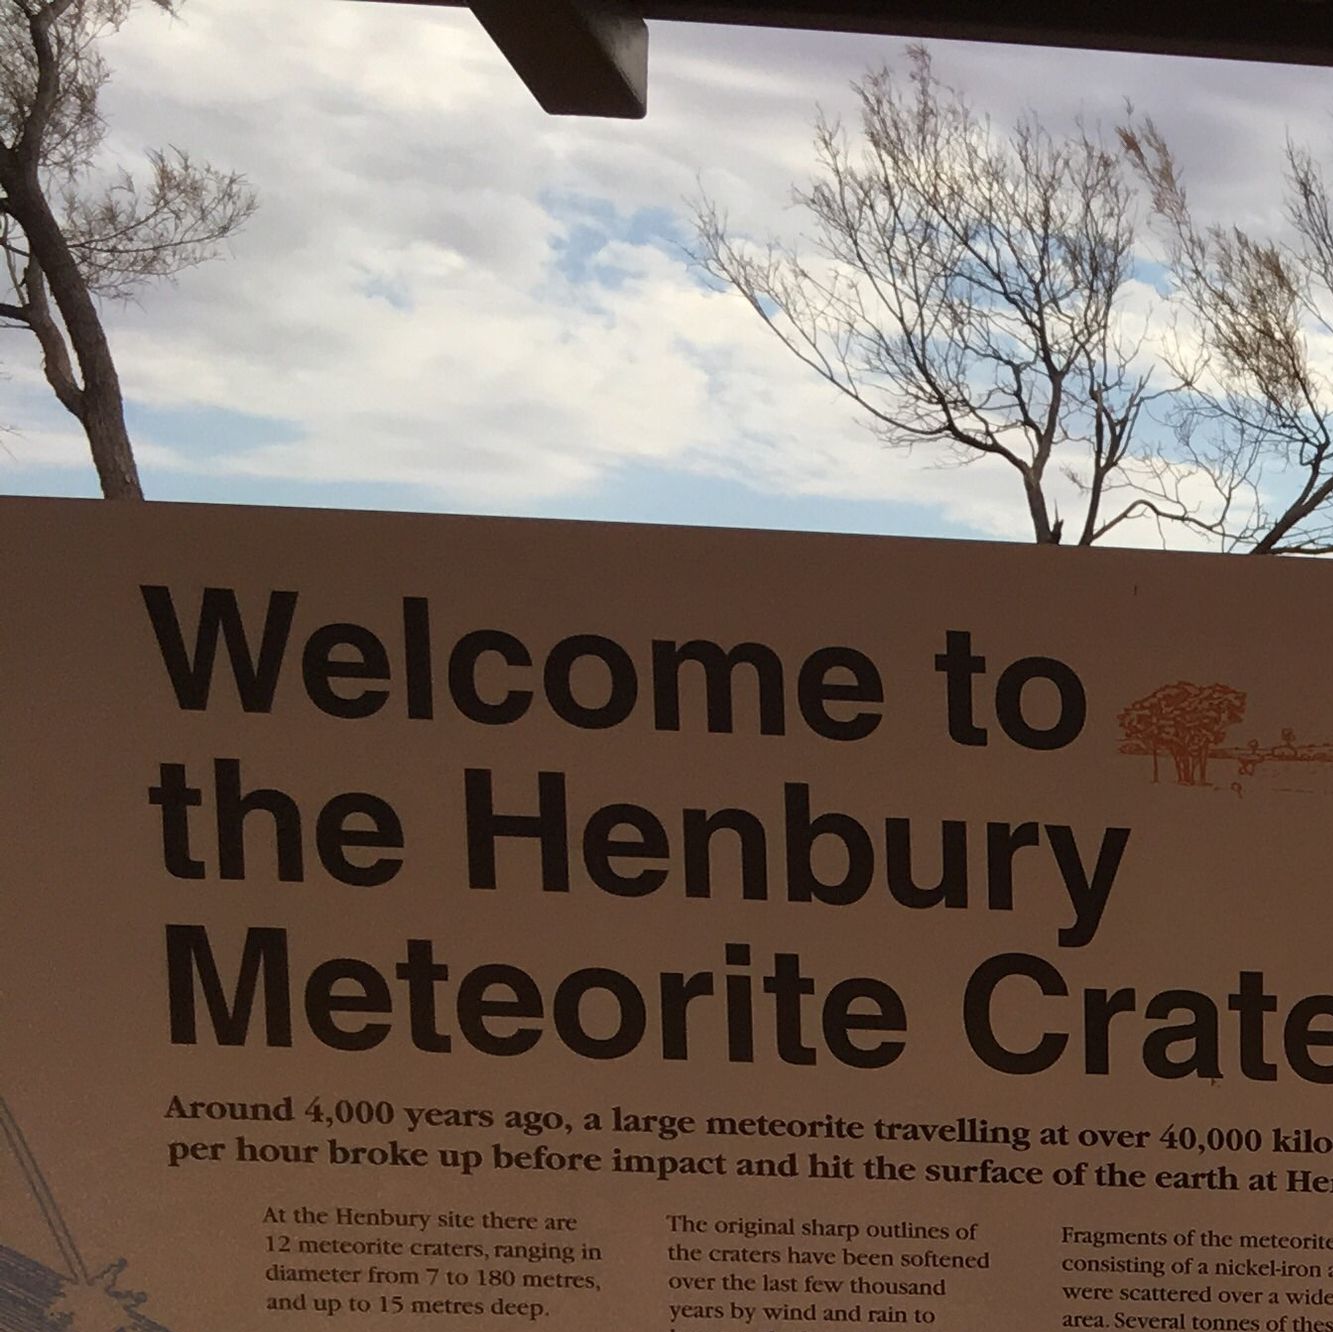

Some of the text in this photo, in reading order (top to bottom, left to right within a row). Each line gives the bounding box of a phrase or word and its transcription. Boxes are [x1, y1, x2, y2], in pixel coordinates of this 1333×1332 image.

[139, 584, 1087, 751] Welcome to
[147, 757, 1132, 948] the Henbury
[165, 923, 908, 1069] Meteorite
[164, 1095, 295, 1122] Around
[304, 1096, 395, 1127] 4,000
[403, 1107, 494, 1133] years
[505, 1111, 573, 1136] ago,
[583, 1113, 602, 1131] a
[612, 1106, 695, 1141] large
[706, 1114, 865, 1140] meteorite
[873, 1117, 1031, 1152] travelling
[1039, 1125, 1069, 1146] at
[1077, 1129, 1151, 1148] over
[1159, 1123, 1262, 1154] 40,000
[263, 1206, 578, 1232] At the Henbury site there are
